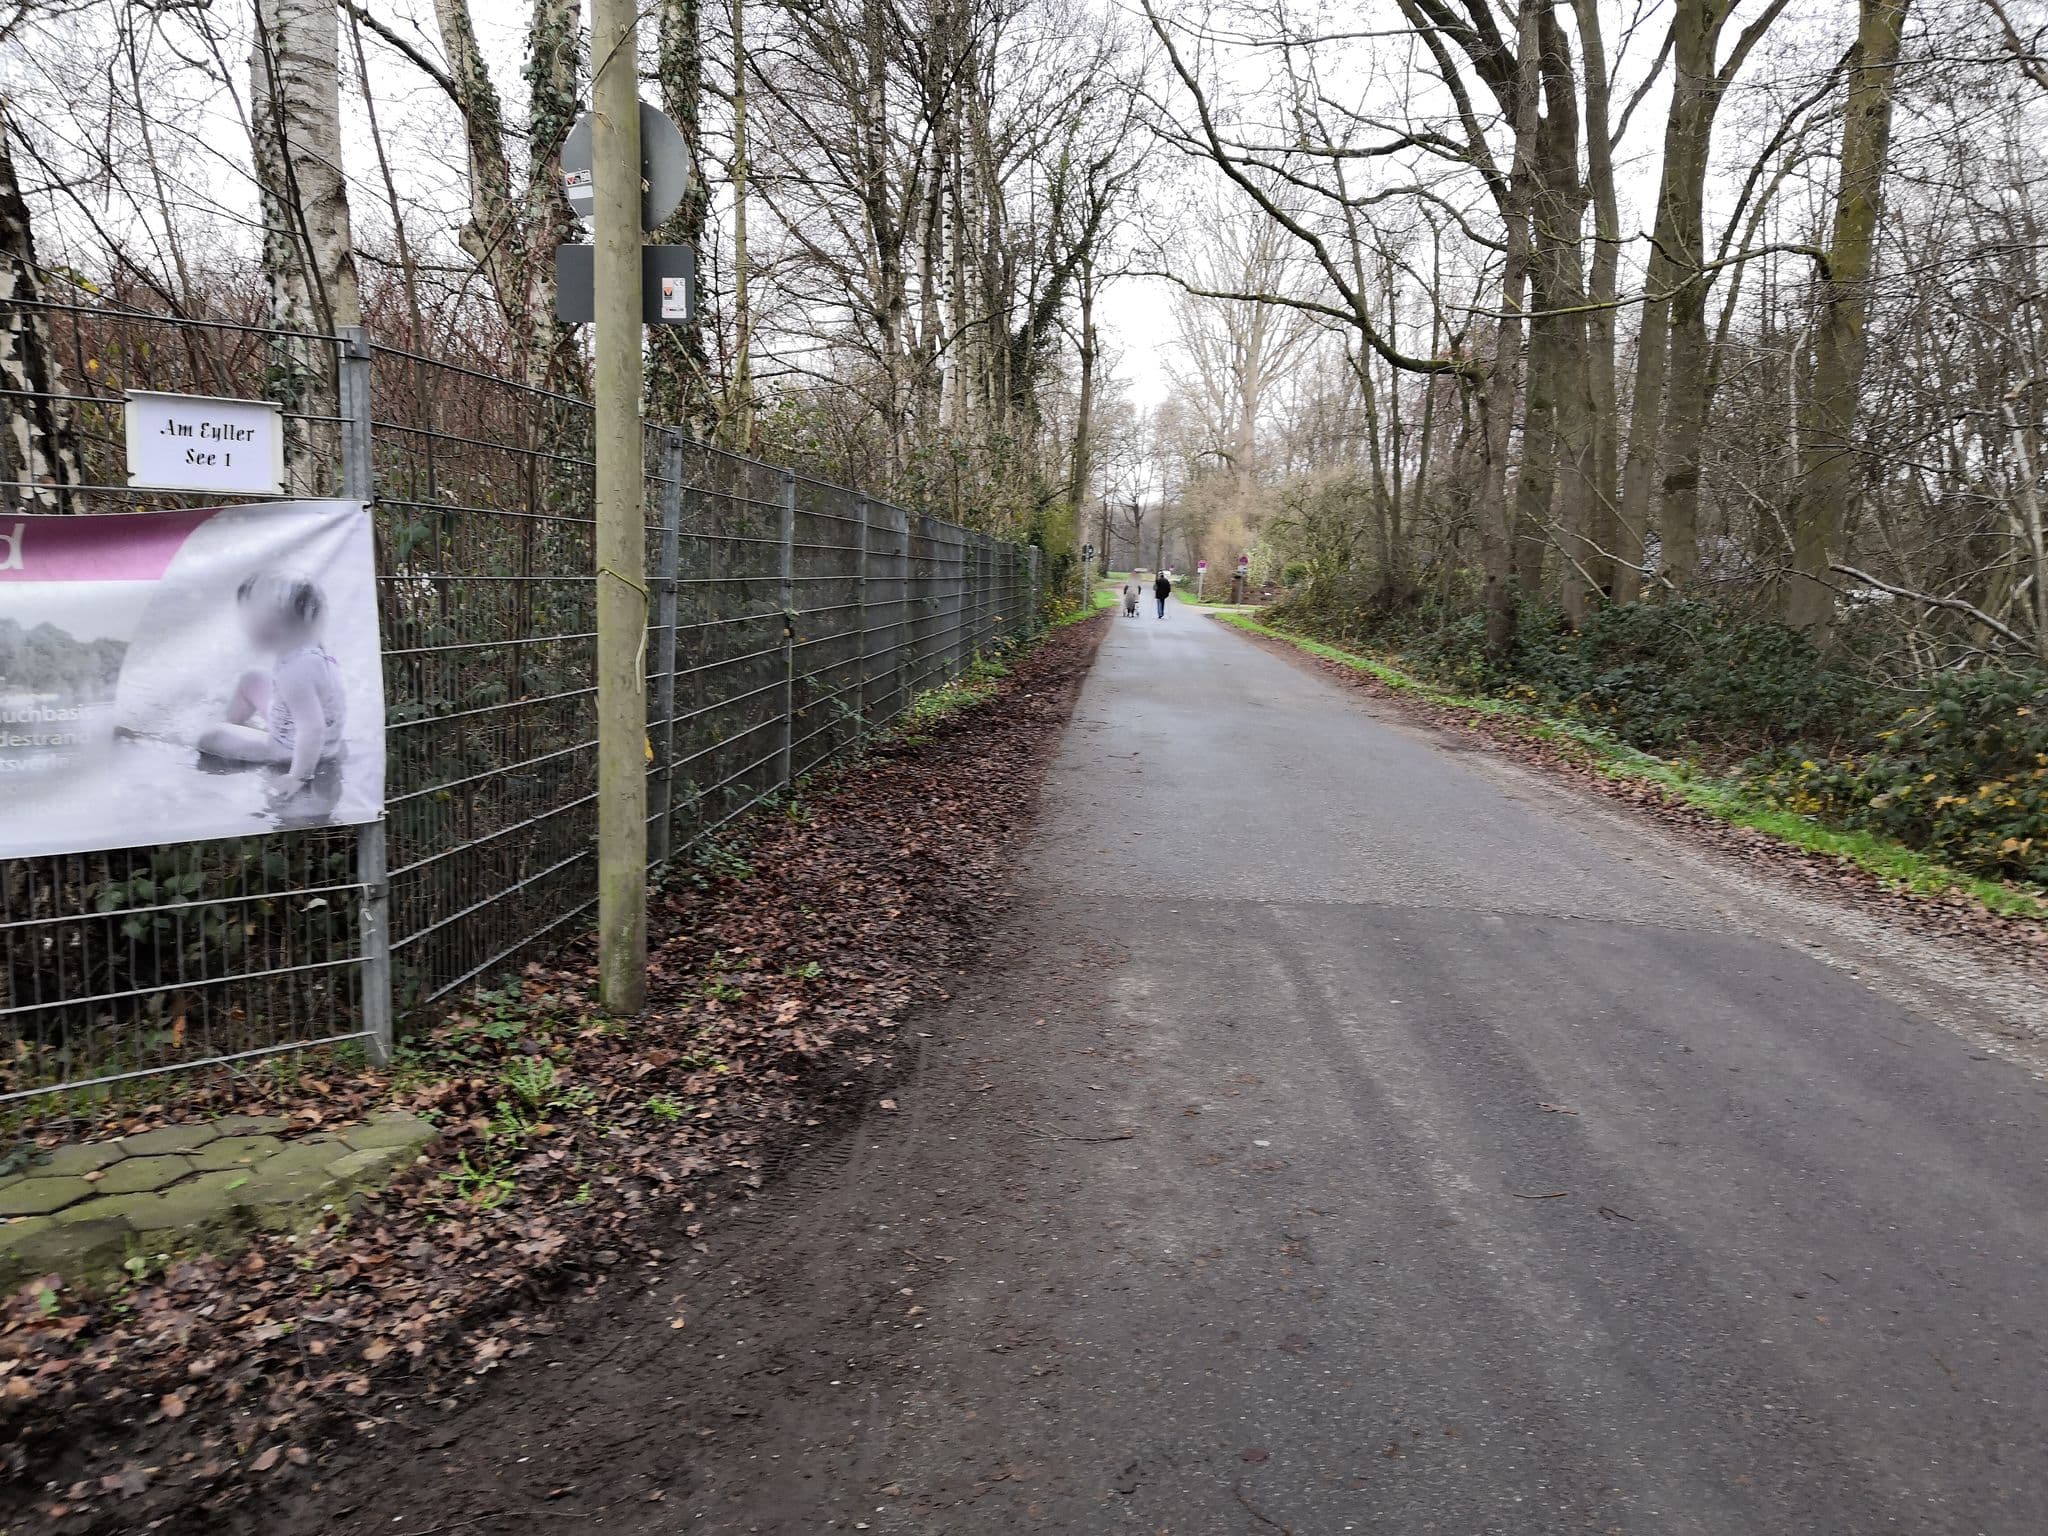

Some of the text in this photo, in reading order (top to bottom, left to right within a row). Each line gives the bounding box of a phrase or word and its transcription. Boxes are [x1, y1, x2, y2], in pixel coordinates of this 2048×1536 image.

[160, 419, 255, 442] Am Eyller
[186, 448, 216, 466] See
